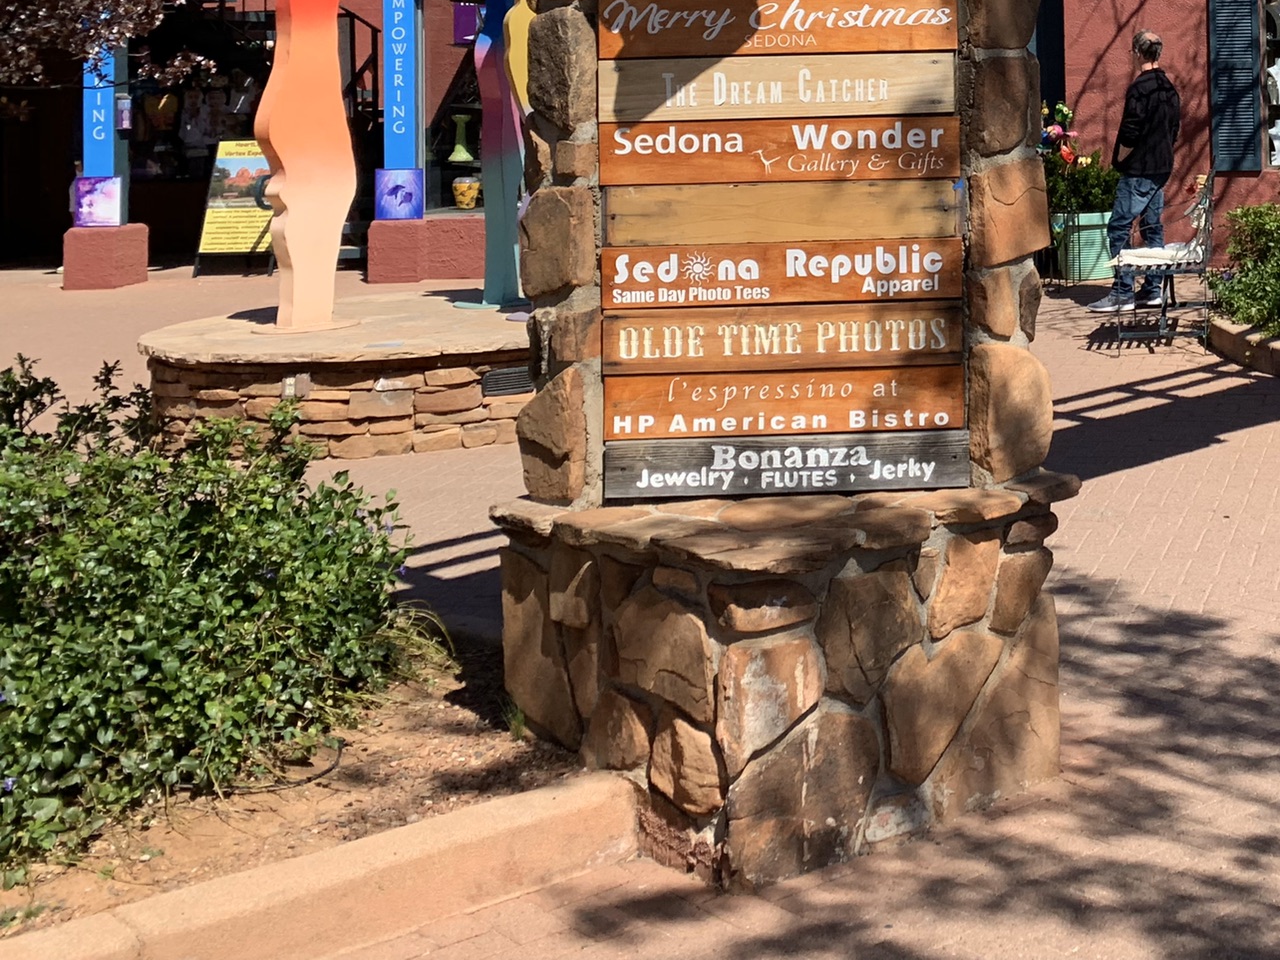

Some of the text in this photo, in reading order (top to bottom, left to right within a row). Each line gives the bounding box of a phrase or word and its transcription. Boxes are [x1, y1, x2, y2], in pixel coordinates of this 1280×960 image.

[743, 33, 818, 49] SEDONA
[613, 121, 945, 156] Sedona Wonder
[787, 150, 945, 178] Gallery & Gifts
[785, 244, 943, 284] Republic
[612, 284, 770, 304] Same Day Photo Tees
[861, 275, 940, 298] Apparel
[617, 317, 947, 360] OLDE TIME PHOTOS
[667, 377, 899, 413] l'espressino at
[612, 409, 950, 435] HP American Bistro
[710, 445, 872, 472] Bonanza
[635, 457, 936, 491] Jewelry FLUTES Jerky
